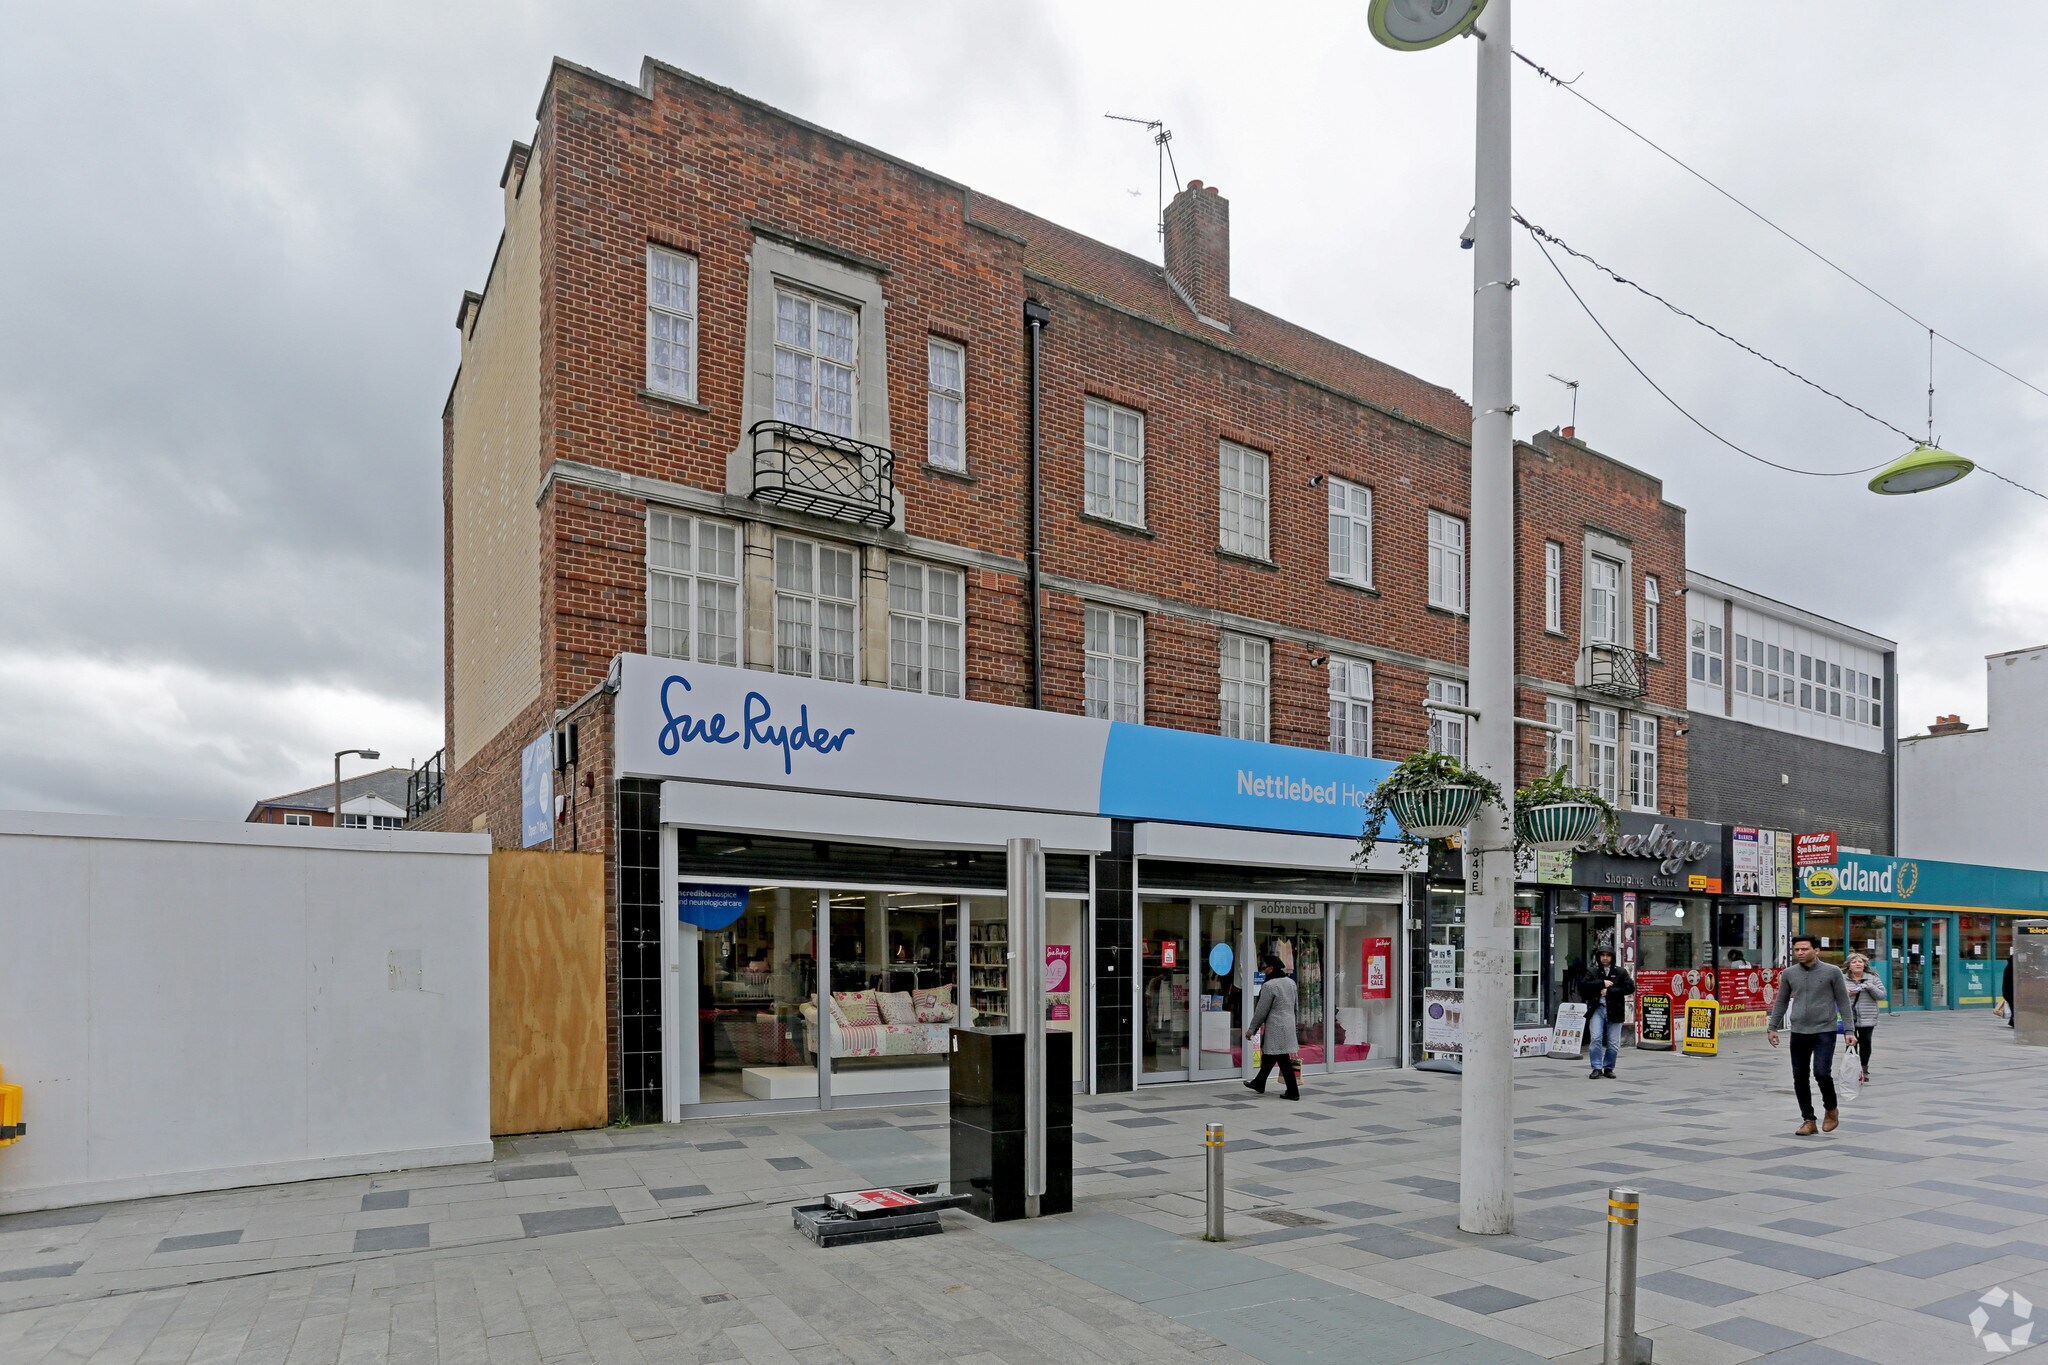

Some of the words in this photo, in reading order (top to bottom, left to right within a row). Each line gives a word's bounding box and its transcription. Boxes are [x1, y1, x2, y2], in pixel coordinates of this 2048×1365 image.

[658, 675, 740, 755] Sue
[743, 691, 855, 775] Ryder
[1237, 769, 1337, 805] Nettlebed
[1798, 834, 1830, 844] Nails
[1812, 845, 1831, 853] Beauty
[1605, 872, 1645, 887] Shopping
[1651, 875, 1678, 887] Centre
[678, 889, 712, 897] ncredible
[712, 891, 737, 899] hospice
[689, 899, 728, 908] neurological
[1045, 967, 1062, 976] VE
[1643, 996, 1669, 1004] MIRZA
[1719, 1003, 1734, 1011] AILS
[1690, 1027, 1711, 1038] HERE
[1523, 1033, 1548, 1043] Service
